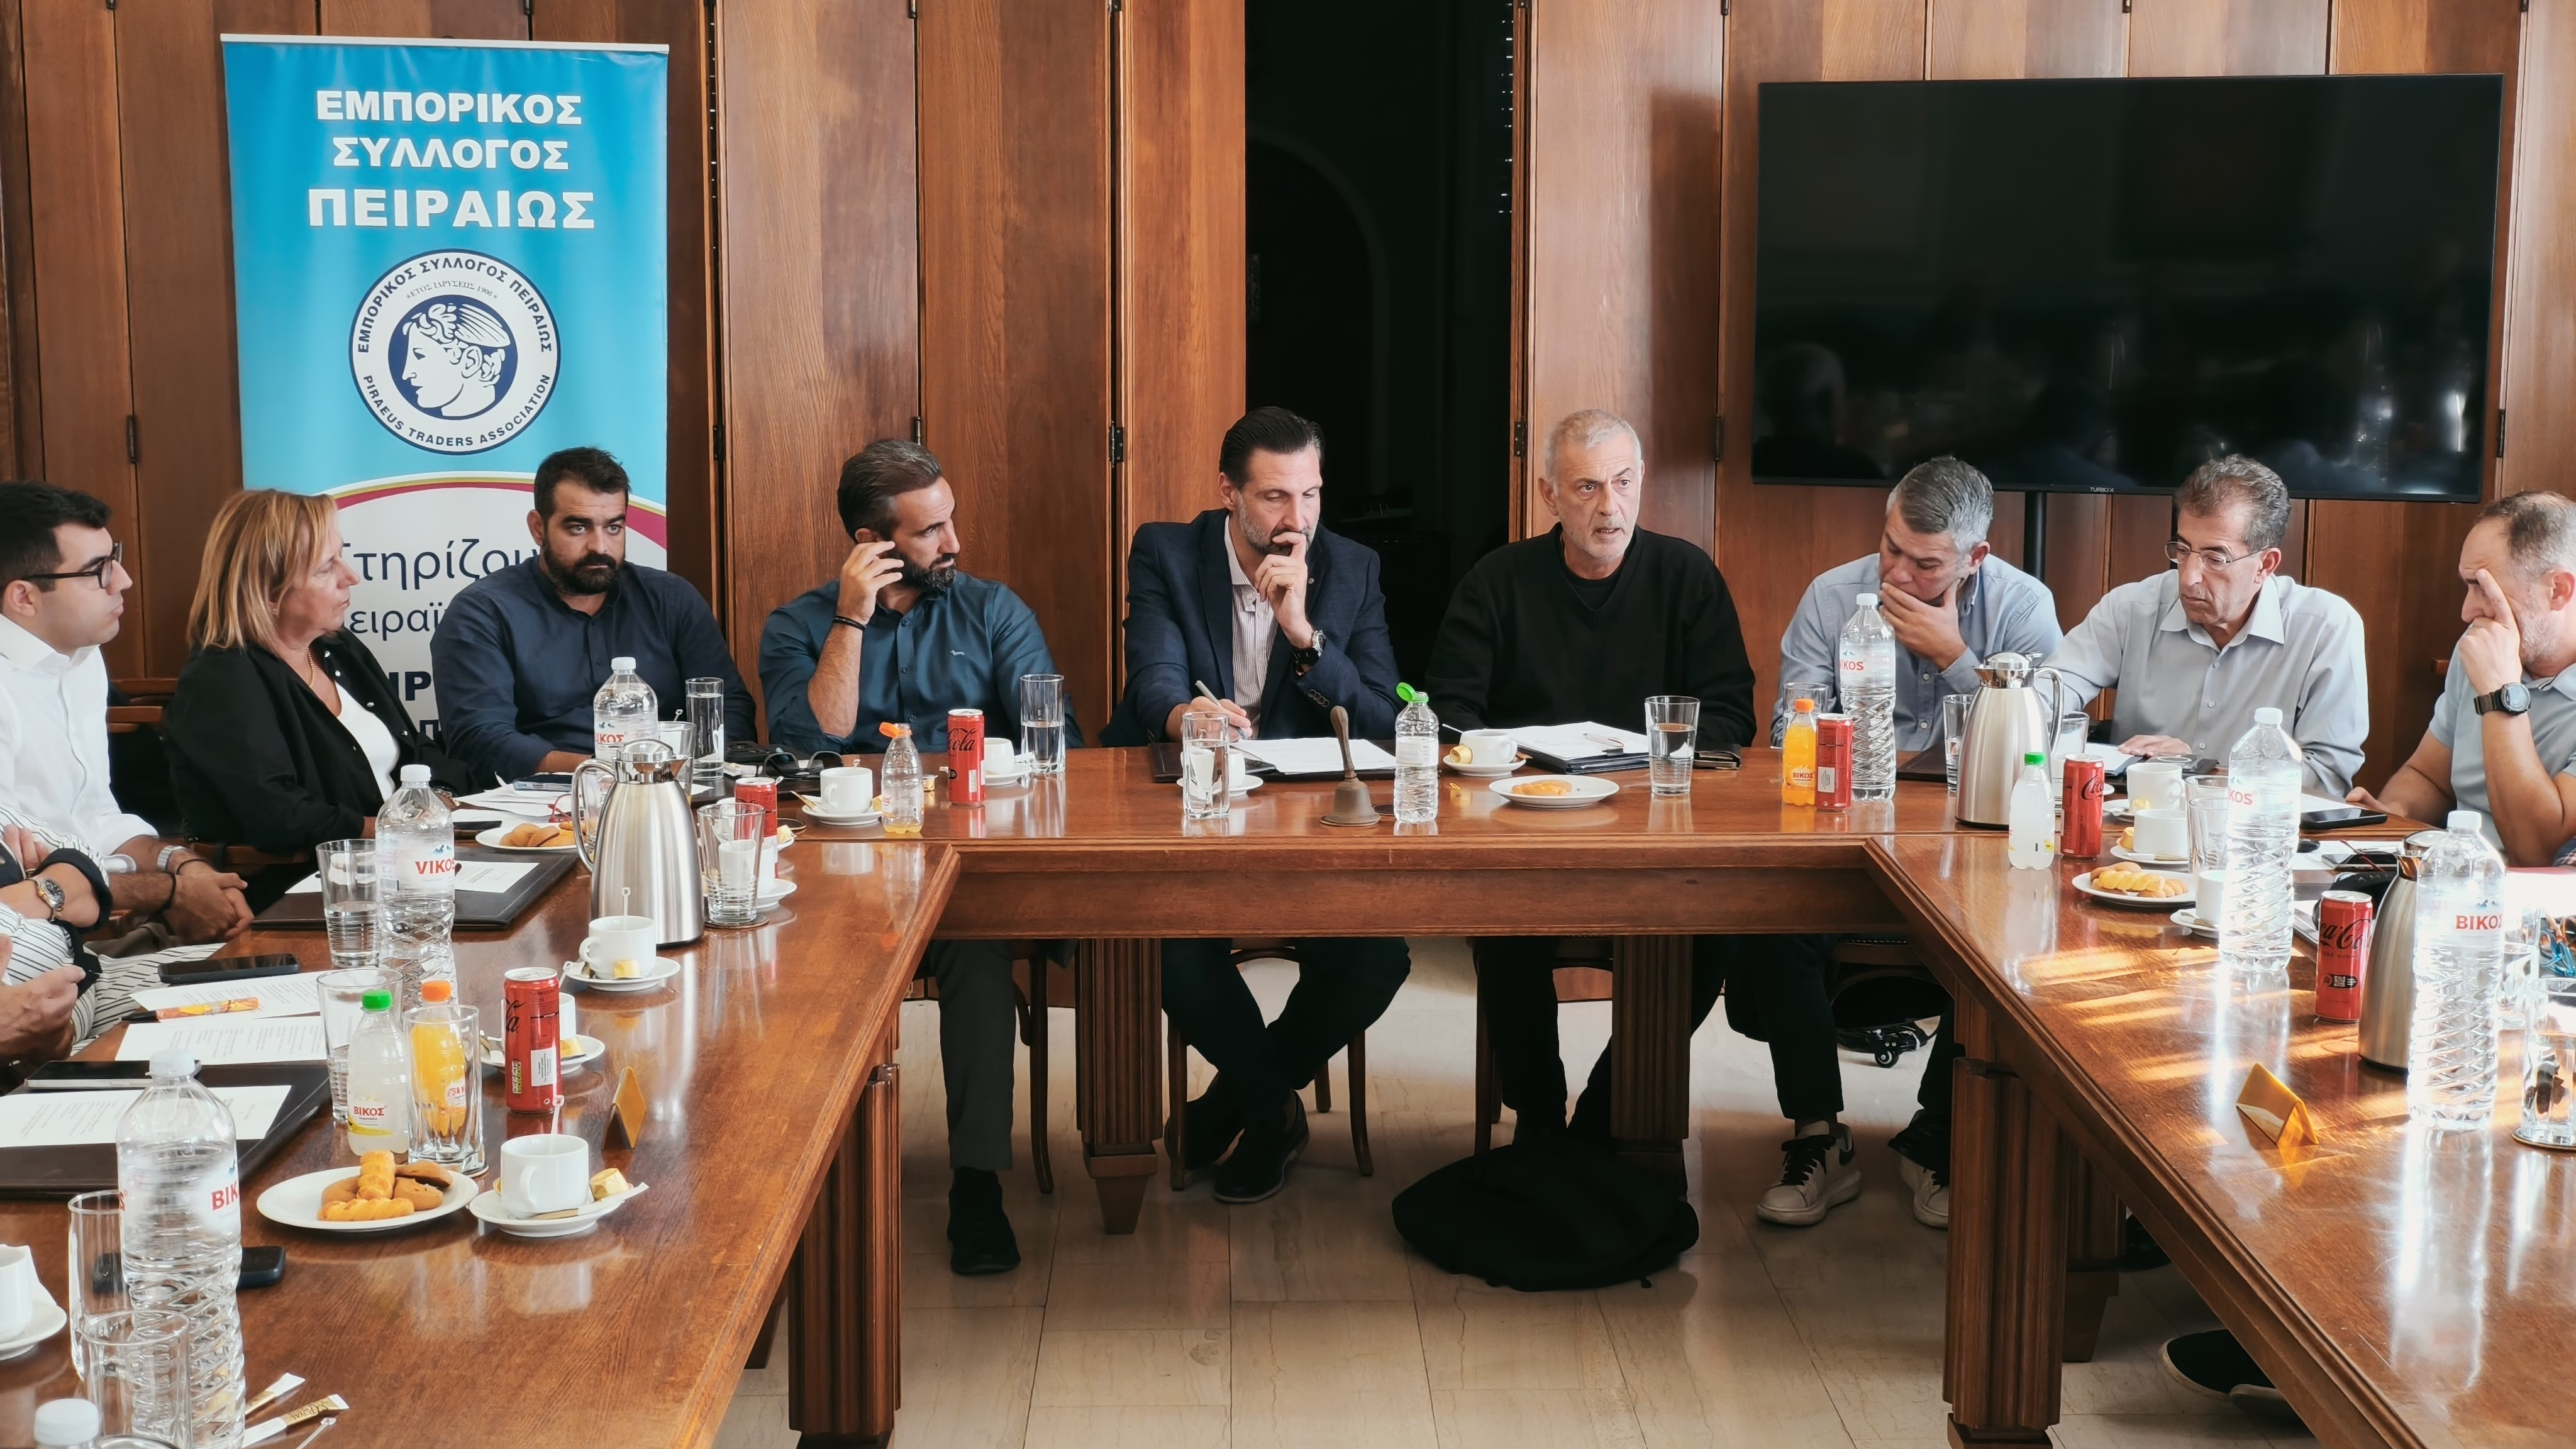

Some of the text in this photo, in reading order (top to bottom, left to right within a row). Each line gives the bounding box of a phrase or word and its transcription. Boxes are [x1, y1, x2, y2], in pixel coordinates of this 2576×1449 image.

[317, 91, 582, 125] ΕΜΠΟΡΙΚΟΣ
[333, 138, 569, 170] ΣΥΛΛΟΓΟΣ
[309, 189, 595, 229] ΠΕΙΡΑΙΩΣ
[358, 257, 552, 353] ΕΜΠΟΡΙΚΟΣ ΣΥΛΛΟΓΟΣ ΠΕΙΡΑΙΩΣ
[410, 284, 433, 297] ΕΤΟΣ
[477, 286, 493, 297] 1900
[364, 374, 550, 447] PIRAEUS TRADERS ASSOCIATION
[349, 602, 447, 641] ειραϊ
[1840, 659, 1864, 672] IKOS
[353, 1106, 385, 1116] ΒΙΚΟΣ
